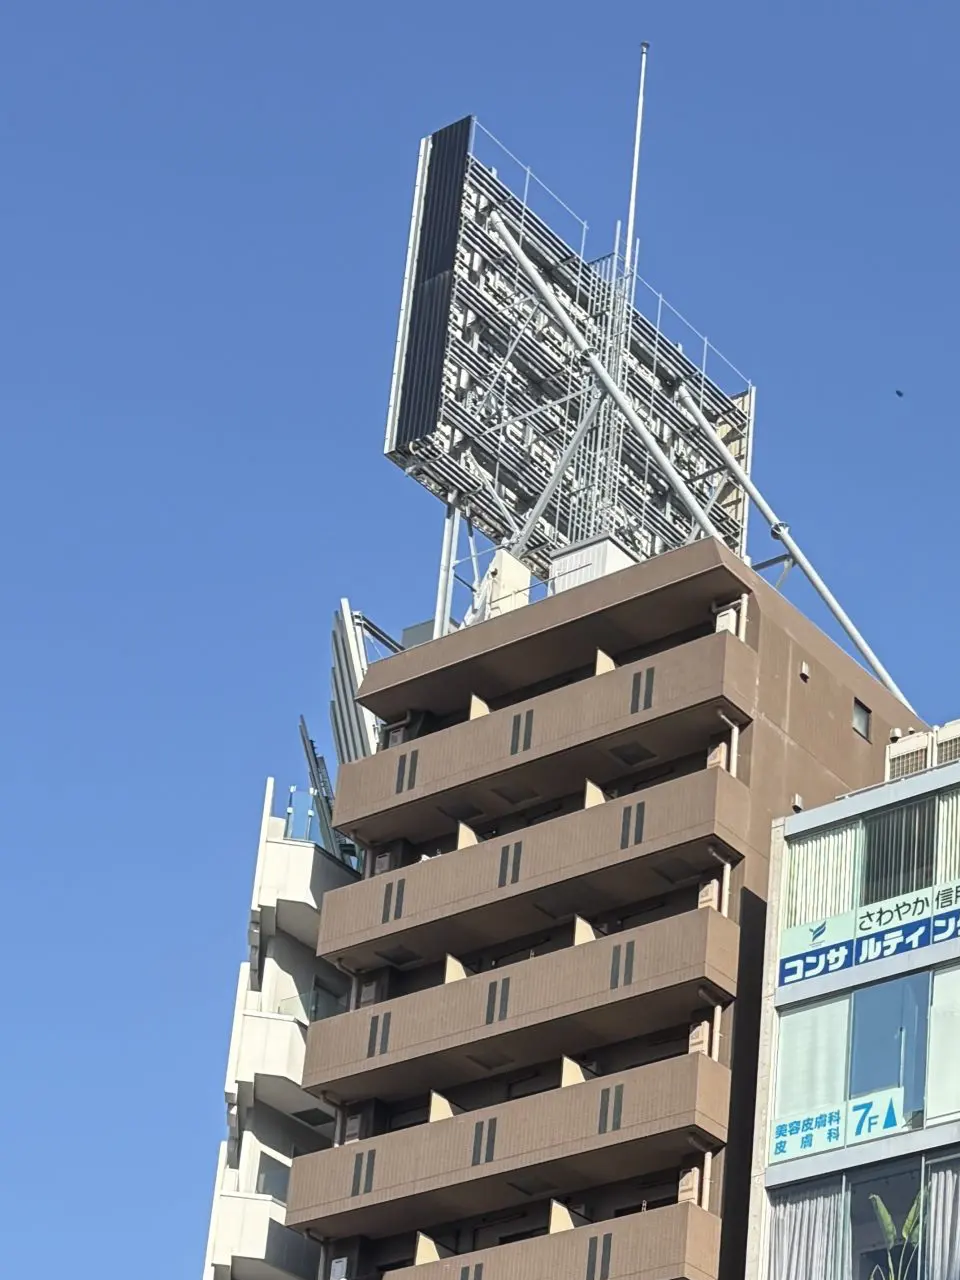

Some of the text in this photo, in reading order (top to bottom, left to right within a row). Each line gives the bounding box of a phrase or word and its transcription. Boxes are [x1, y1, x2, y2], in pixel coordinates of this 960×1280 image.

[775, 1109, 841, 1139] 美容皮膚科
[852, 1101, 880, 1136] 7F
